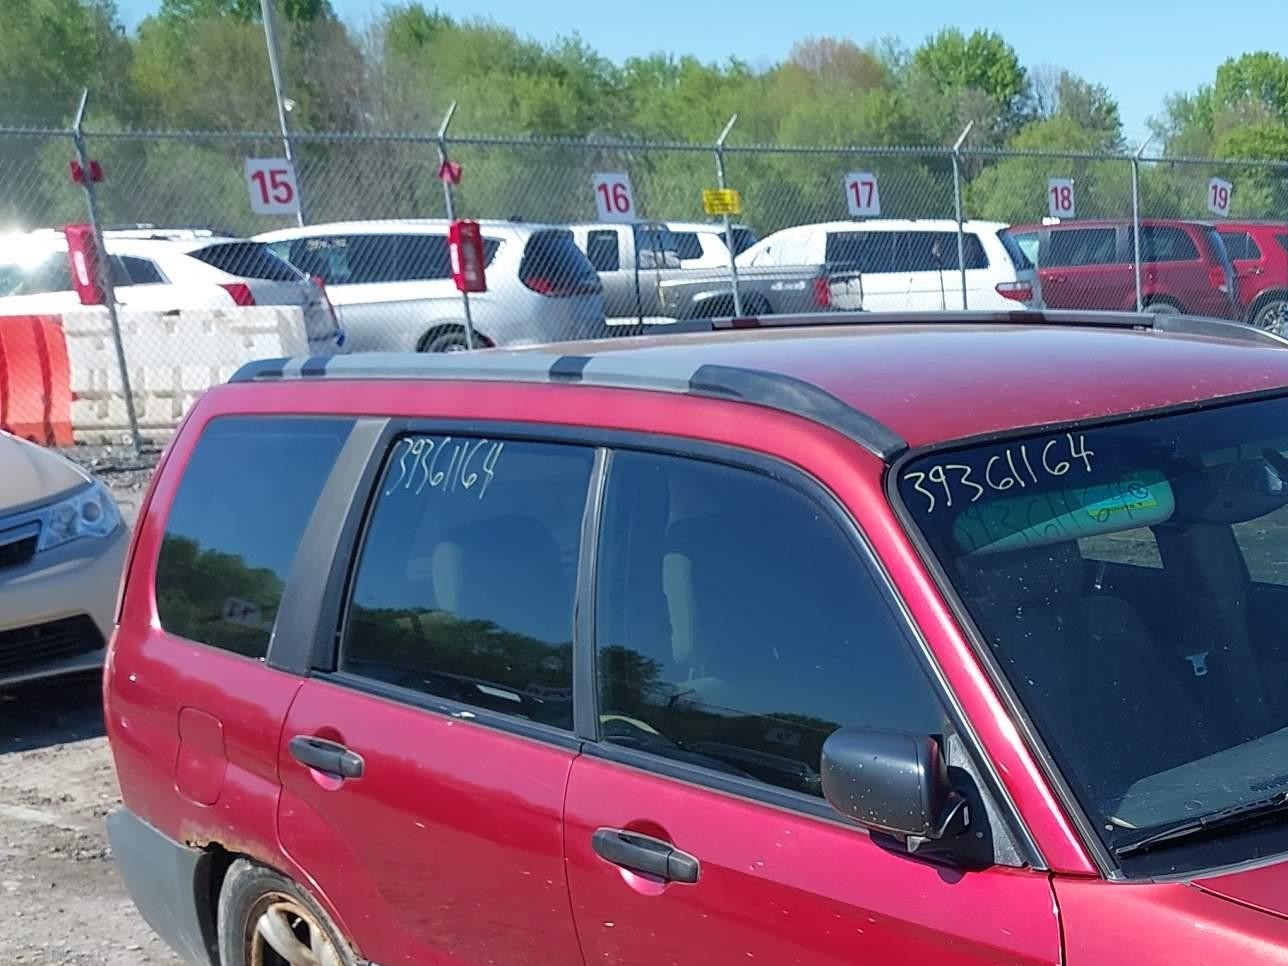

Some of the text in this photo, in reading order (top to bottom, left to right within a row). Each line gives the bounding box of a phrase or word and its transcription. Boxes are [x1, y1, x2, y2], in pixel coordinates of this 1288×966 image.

[250, 169, 294, 205] 15
[597, 182, 631, 214] 16
[849, 181, 874, 209] 17
[1050, 186, 1073, 211] 18
[1210, 184, 1228, 210] 19
[386, 436, 504, 500] 39361164
[903, 433, 1095, 513] 39361164
